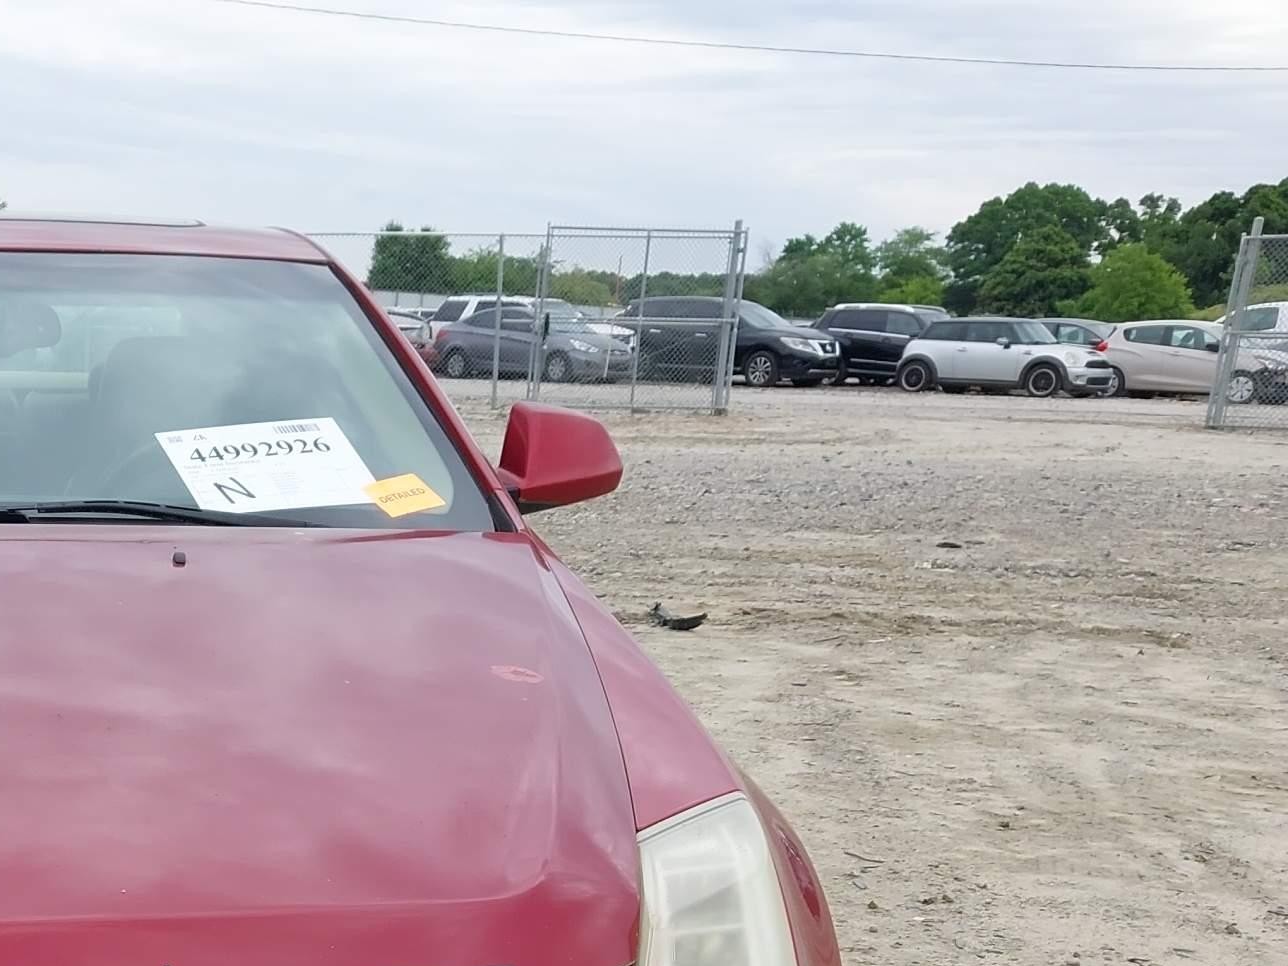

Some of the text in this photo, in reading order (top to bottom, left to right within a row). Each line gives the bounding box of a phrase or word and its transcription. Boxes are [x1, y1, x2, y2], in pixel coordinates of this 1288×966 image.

[190, 436, 331, 462] 44992926
[213, 477, 257, 504] N
[379, 487, 426, 504] DETAILED
